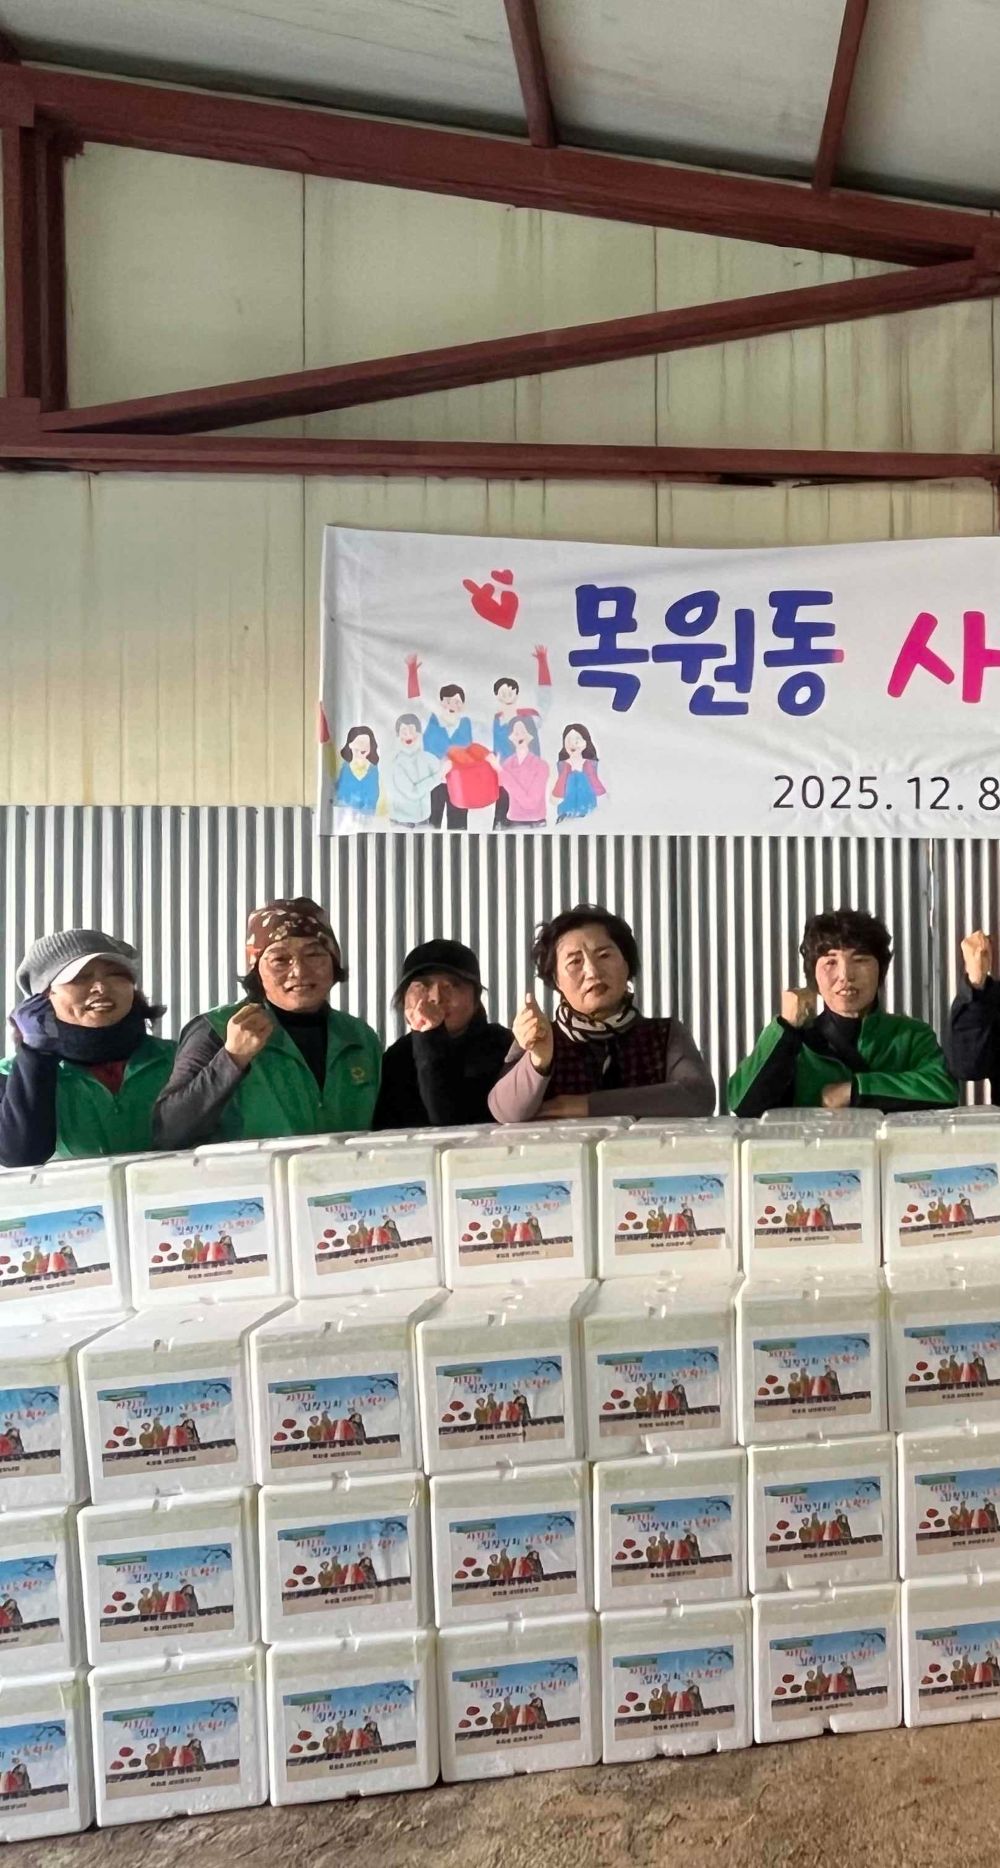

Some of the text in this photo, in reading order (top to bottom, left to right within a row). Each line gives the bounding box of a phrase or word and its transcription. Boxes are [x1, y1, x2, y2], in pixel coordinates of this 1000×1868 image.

[570, 585, 844, 714] 목원동
[773, 775, 893, 810] 2025.
[907, 776, 964, 811] 12.
